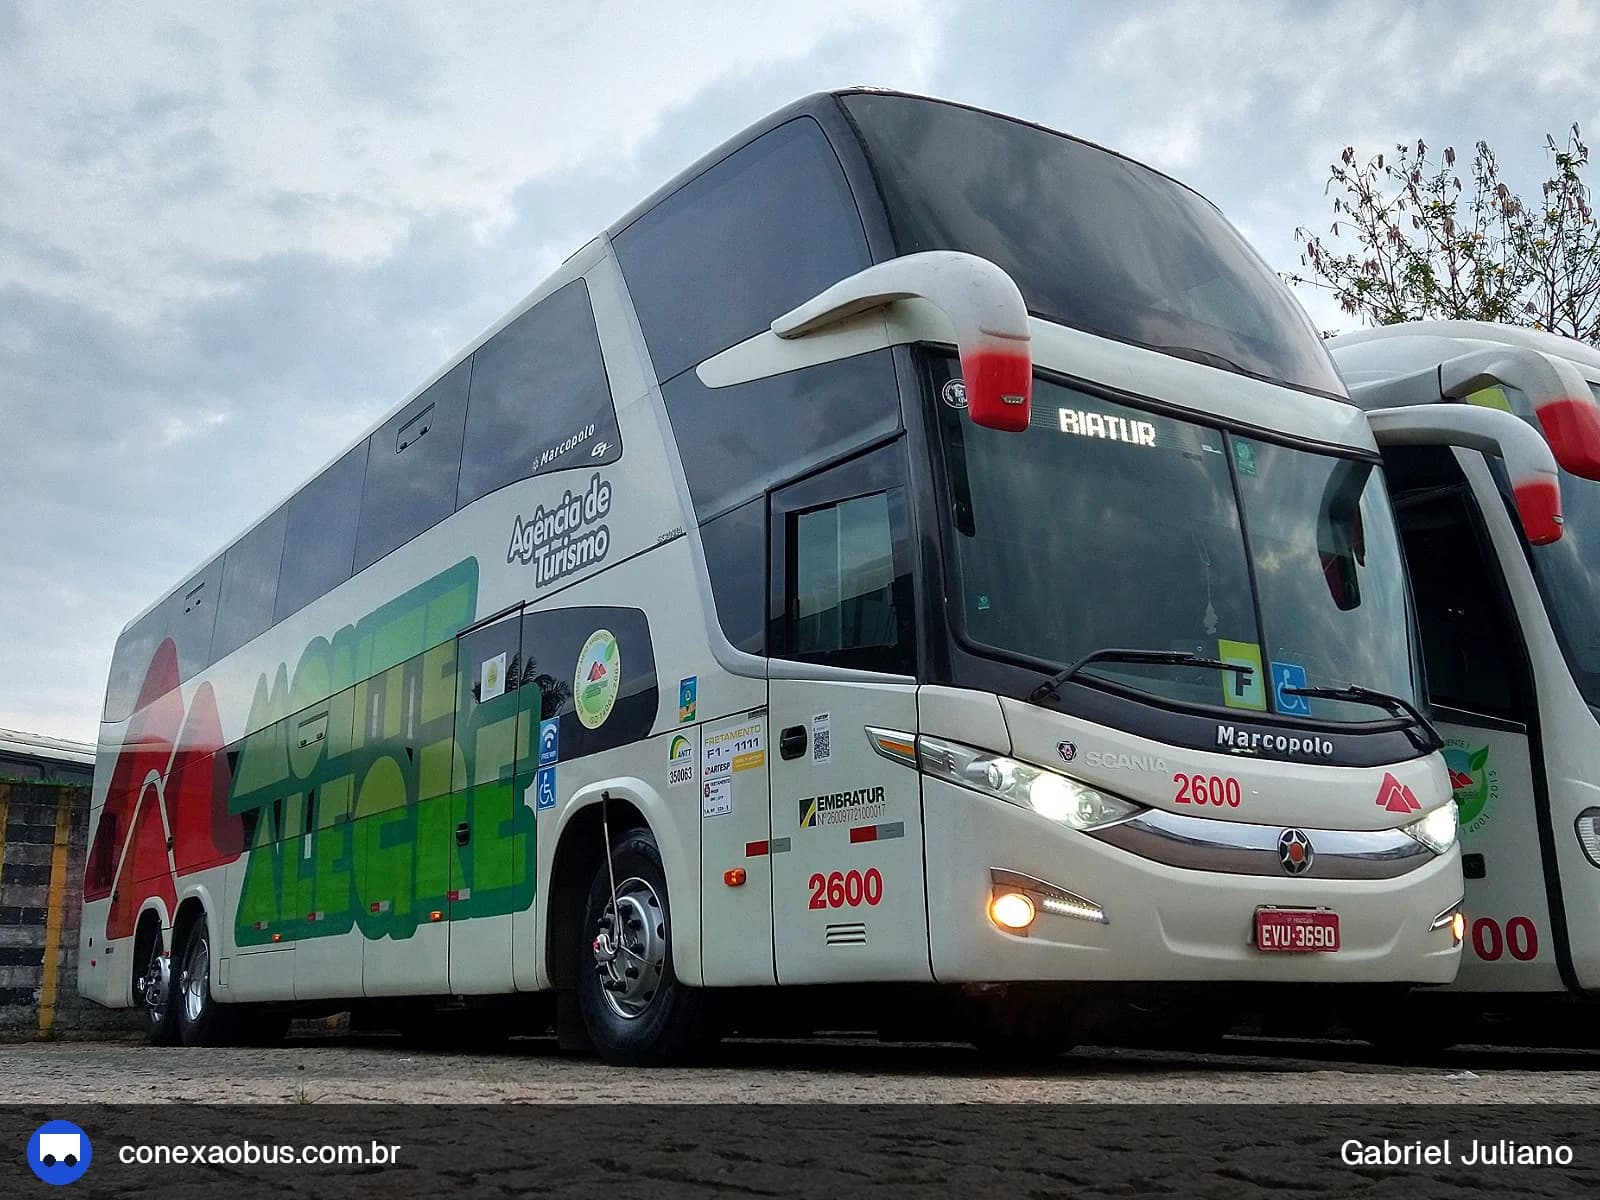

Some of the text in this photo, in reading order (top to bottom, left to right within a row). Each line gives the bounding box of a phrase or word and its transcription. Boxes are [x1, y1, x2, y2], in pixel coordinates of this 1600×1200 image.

[1058, 407, 1157, 448] BIATUR
[540, 423, 595, 467] Marcopolo
[508, 475, 611, 562] Agência de
[534, 527, 608, 585] Turismo
[231, 565, 474, 806] MONTE
[1235, 672, 1254, 696] F
[704, 724, 761, 746] FRETAMENTO
[707, 747, 721, 760] F1
[735, 737, 759, 752] 1111
[1217, 726, 1334, 756] Marcopolo
[678, 749, 692, 758] ANTT
[709, 761, 731, 774] ARTESP
[1085, 751, 1169, 774] SCANIA
[669, 766, 692, 784] 350063
[1173, 773, 1242, 808] 2600
[817, 786, 885, 812] EMBRATUR
[237, 698, 537, 935] ALEGRE
[808, 867, 883, 910] 2600
[1471, 916, 1538, 961] 00
